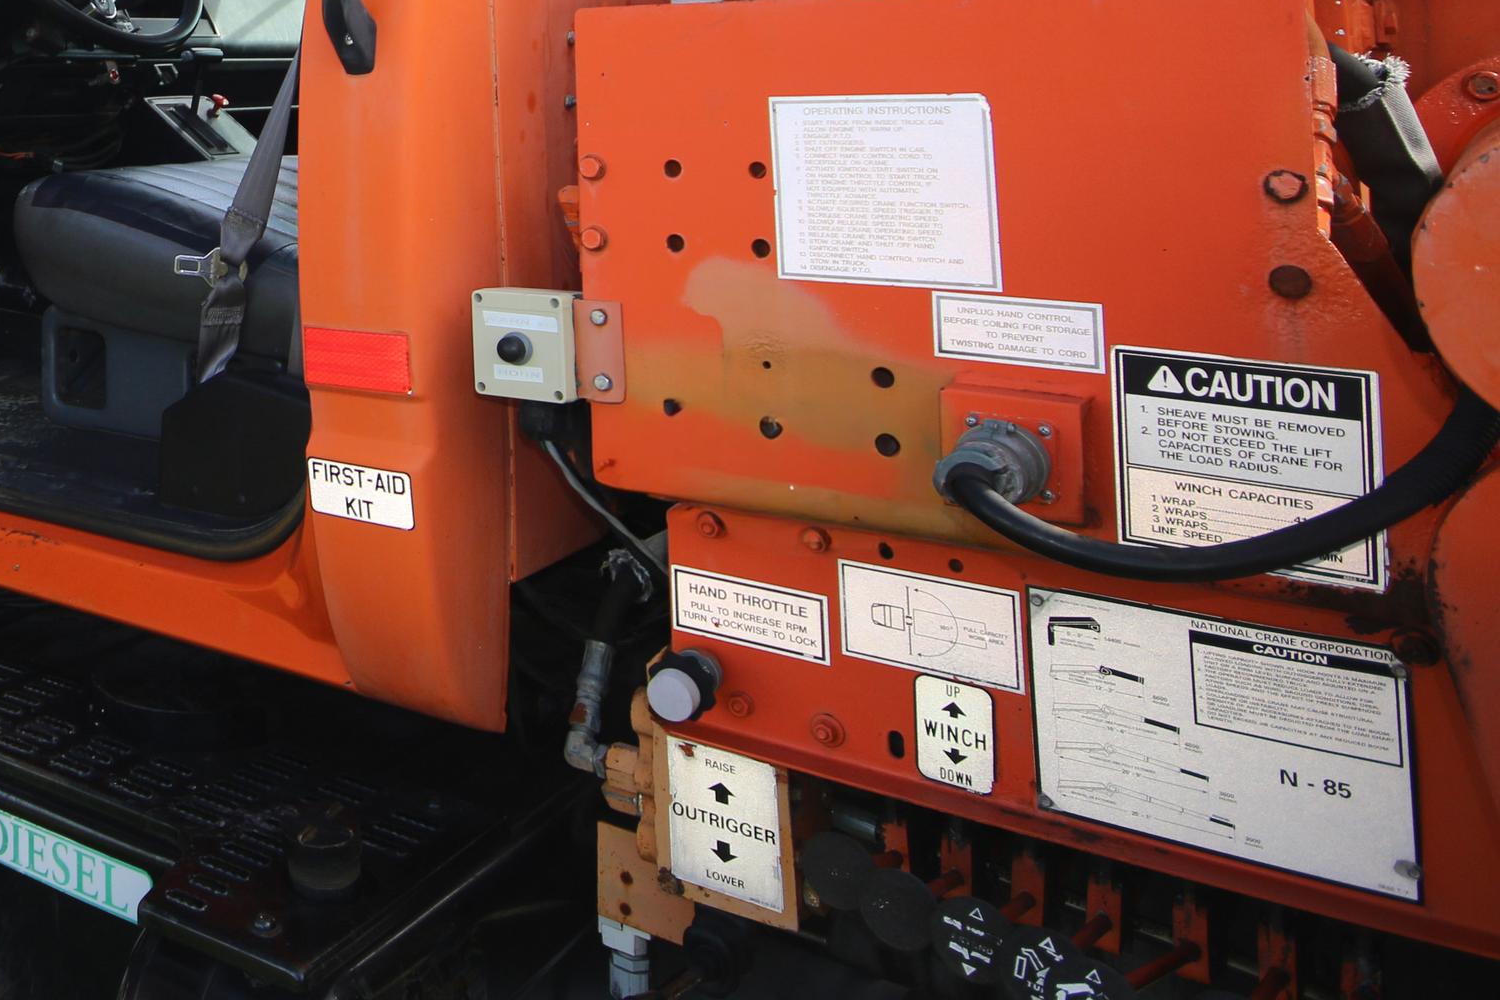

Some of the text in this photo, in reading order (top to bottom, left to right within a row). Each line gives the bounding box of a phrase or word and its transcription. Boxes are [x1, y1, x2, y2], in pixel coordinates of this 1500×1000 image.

[803, 105, 950, 116] OPERATING INSTRUCTIONS
[944, 316, 1091, 336] BEFORE COILING FOR STORAGE
[957, 307, 1074, 323] UNPLUG HAND CONTROL
[986, 331, 1045, 343] TO PREVENT
[950, 339, 1086, 359] TWISTING DAMAGE TO CORD
[1184, 367, 1336, 412] CAUTION
[1140, 405, 1346, 438] 1. SHEAVE MUST BE REMOVED
[1157, 418, 1279, 441] BEFORE STOWING.
[1158, 429, 1176, 439] DO
[1182, 432, 1208, 443] NOT
[1213, 435, 1266, 450] EXCEED
[1272, 443, 1298, 455] THE
[1303, 446, 1332, 458] LIFT
[1159, 439, 1343, 472] CAPACITIES OF CRANE FOR
[1159, 450, 1283, 475] THE LOAD RADIUS.
[312, 461, 405, 495] FIRST-AID
[1175, 481, 1314, 511] WINCH CAPACITIES
[345, 497, 374, 519] KIT
[1152, 505, 1159, 513] 2
[1153, 515, 1160, 523] 3
[1152, 525, 1223, 543] LINE SPEED
[689, 582, 808, 618] HAND THROTTLE
[691, 601, 808, 634] PULL TO INCREASE RPM
[682, 610, 818, 648] TURN CLOCKWISE TO LOCK
[980, 630, 1008, 639] CAPACITY
[1191, 620, 1395, 661] NATIONAL CRANE CORPORATION
[1253, 644, 1328, 665] CAUTION
[946, 684, 960, 698] UP
[924, 718, 987, 751] WINCH
[705, 758, 736, 775] RAISE
[939, 767, 972, 787] DOWN
[1279, 768, 1298, 789] N
[1322, 778, 1352, 799] 85
[672, 801, 776, 846] OUTRIGGER
[706, 869, 745, 889] LOWER
